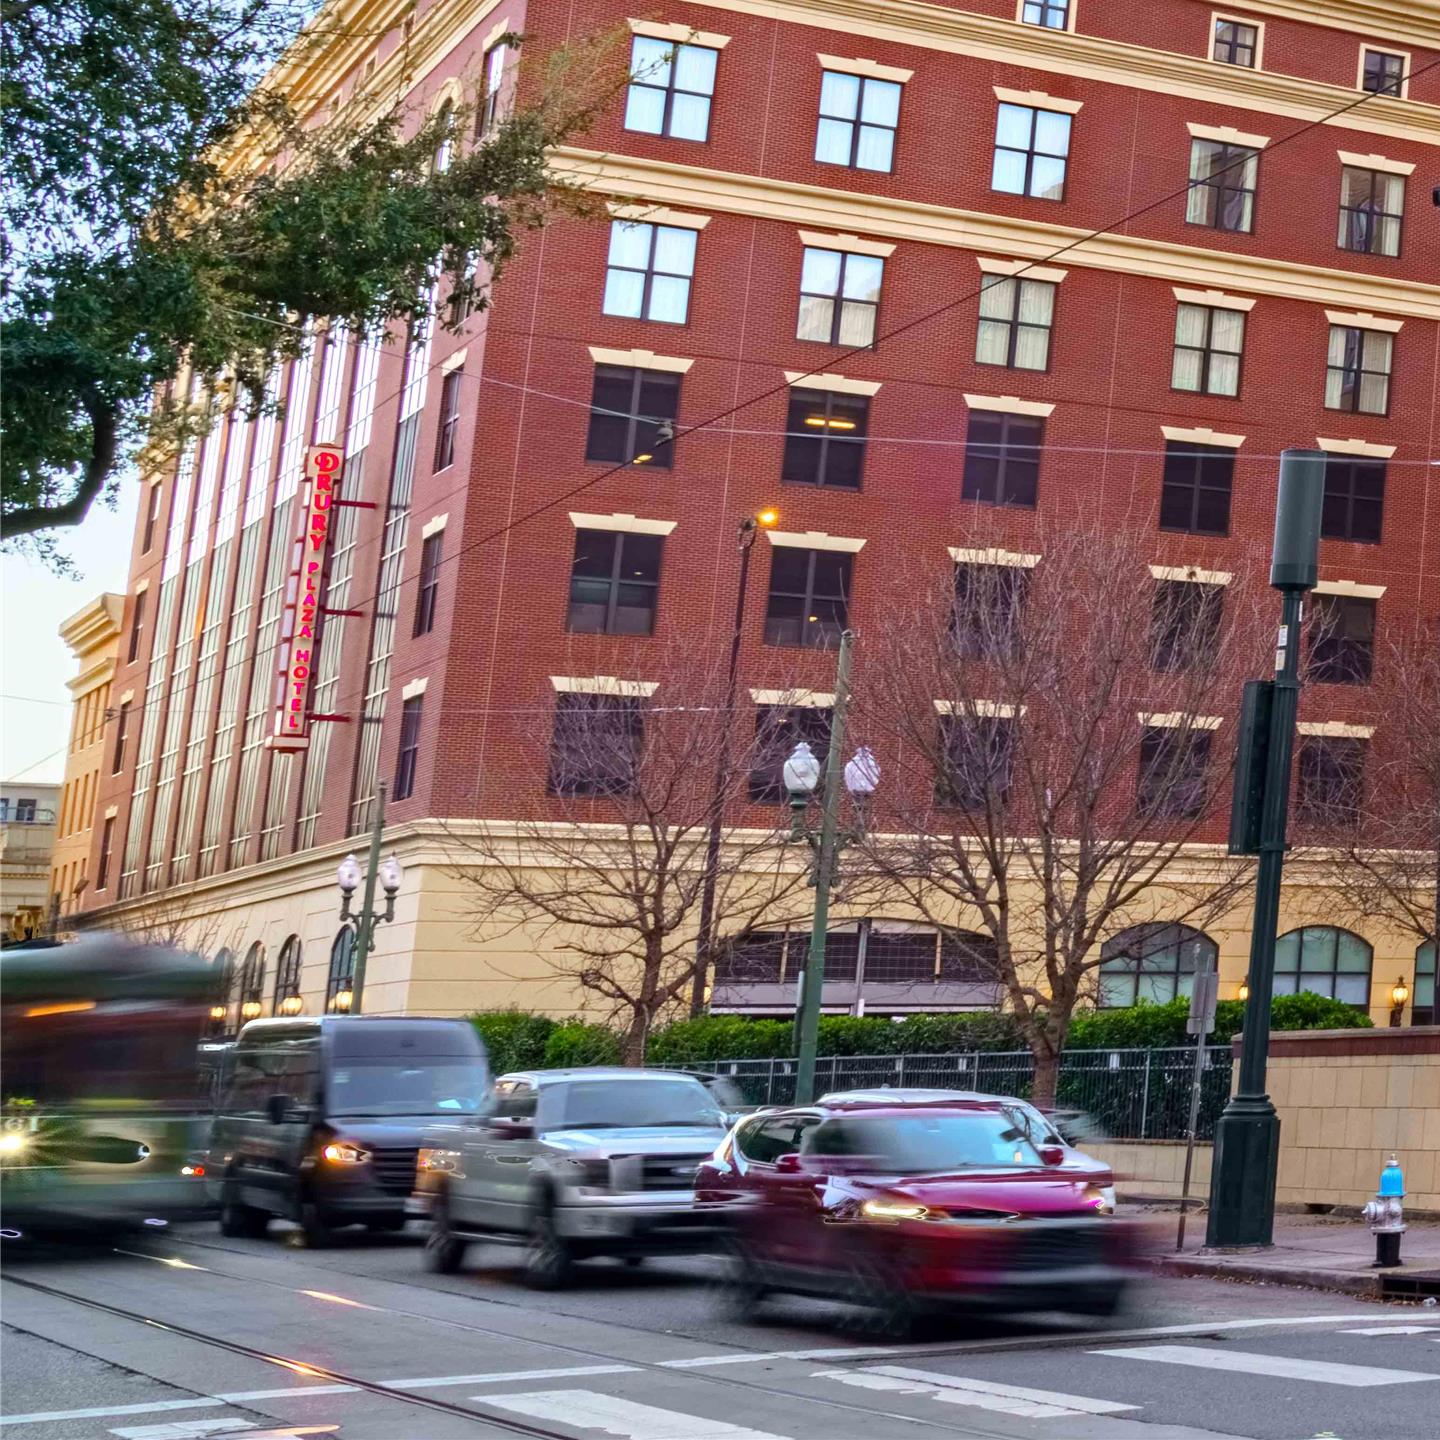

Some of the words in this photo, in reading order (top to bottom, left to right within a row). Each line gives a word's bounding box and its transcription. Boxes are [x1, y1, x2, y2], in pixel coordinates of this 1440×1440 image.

[310, 451, 340, 551] DRURY
[299, 561, 319, 639] PLAZA
[289, 649, 310, 729] HOTEL
